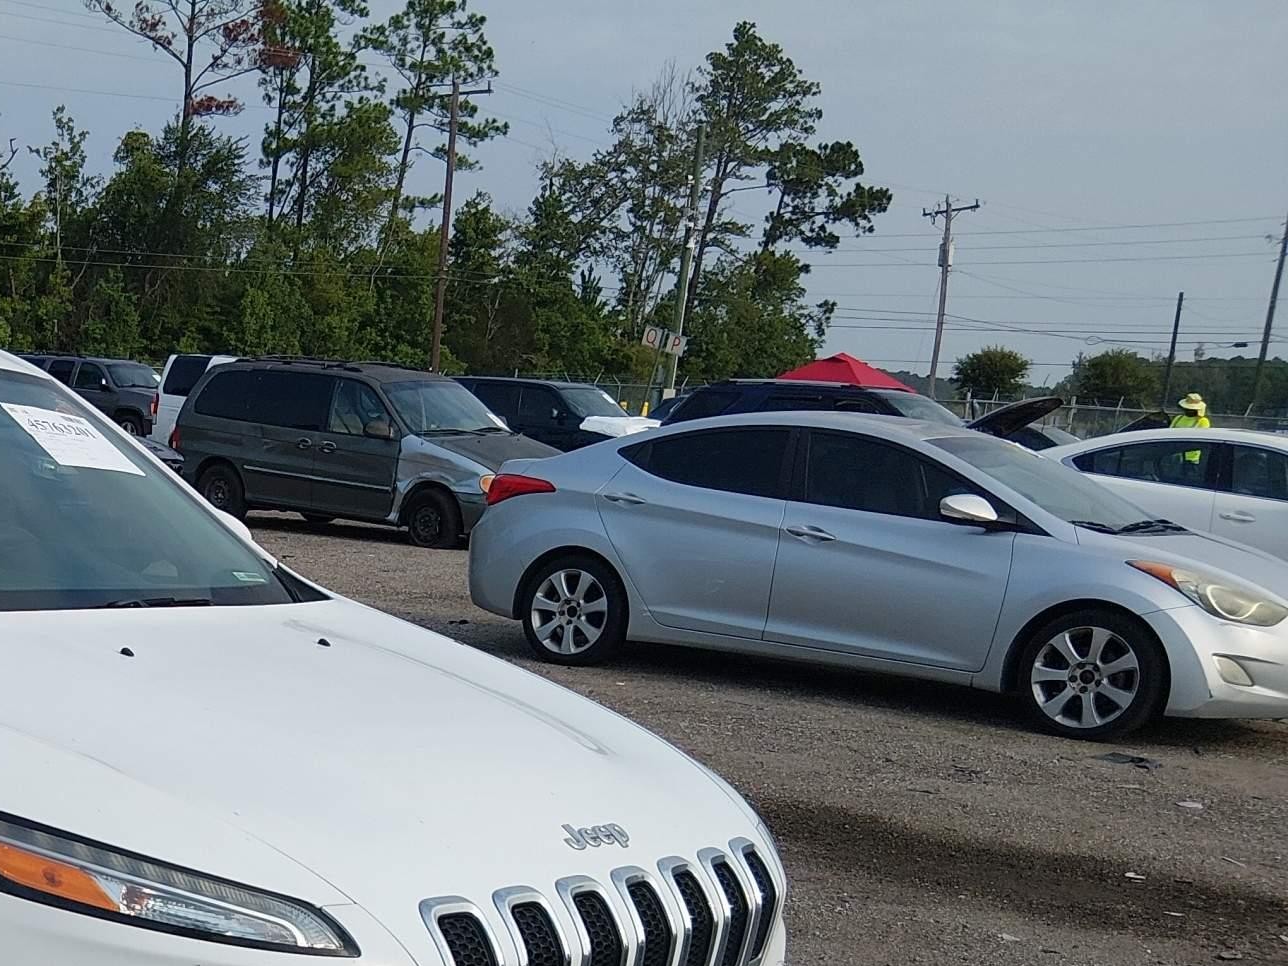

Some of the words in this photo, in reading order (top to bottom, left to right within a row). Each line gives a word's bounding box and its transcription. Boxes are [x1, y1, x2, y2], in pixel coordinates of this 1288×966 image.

[647, 328, 657, 347] Q
[671, 336, 681, 351] P
[27, 418, 96, 439] 45763201
[561, 822, 630, 850] Jeep
